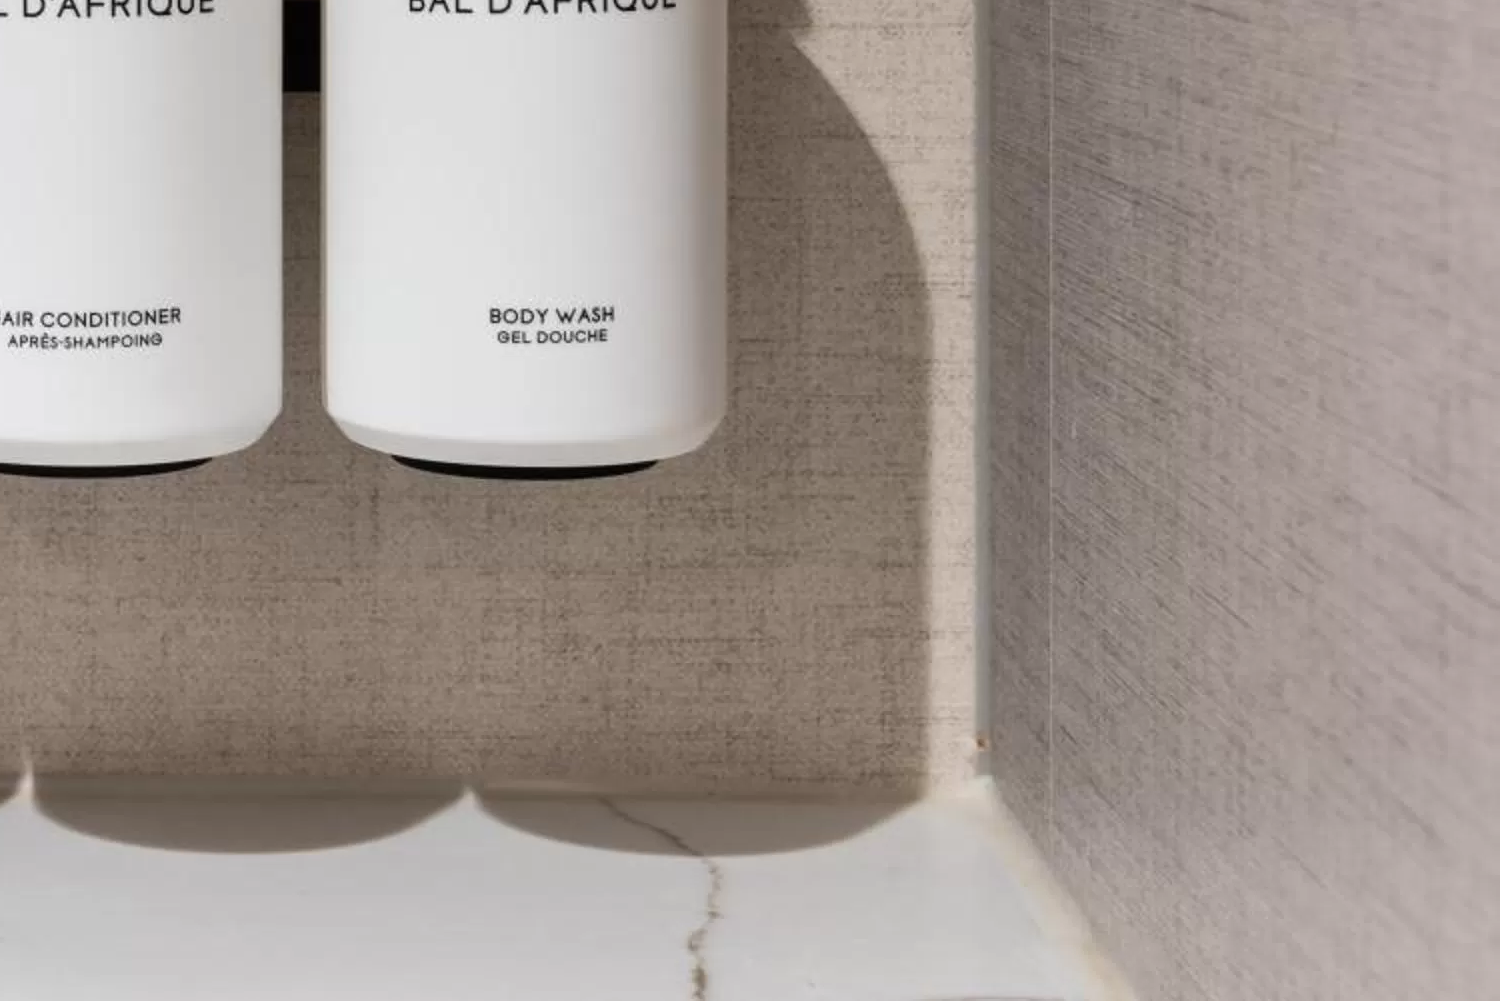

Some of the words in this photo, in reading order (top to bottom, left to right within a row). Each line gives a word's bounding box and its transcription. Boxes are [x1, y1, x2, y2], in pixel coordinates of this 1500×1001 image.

[39, 306, 181, 329] CONDITIONER
[489, 307, 549, 325] BODY
[555, 306, 615, 324] WASH
[497, 330, 532, 344] GEL
[536, 328, 608, 344] DOUCHE
